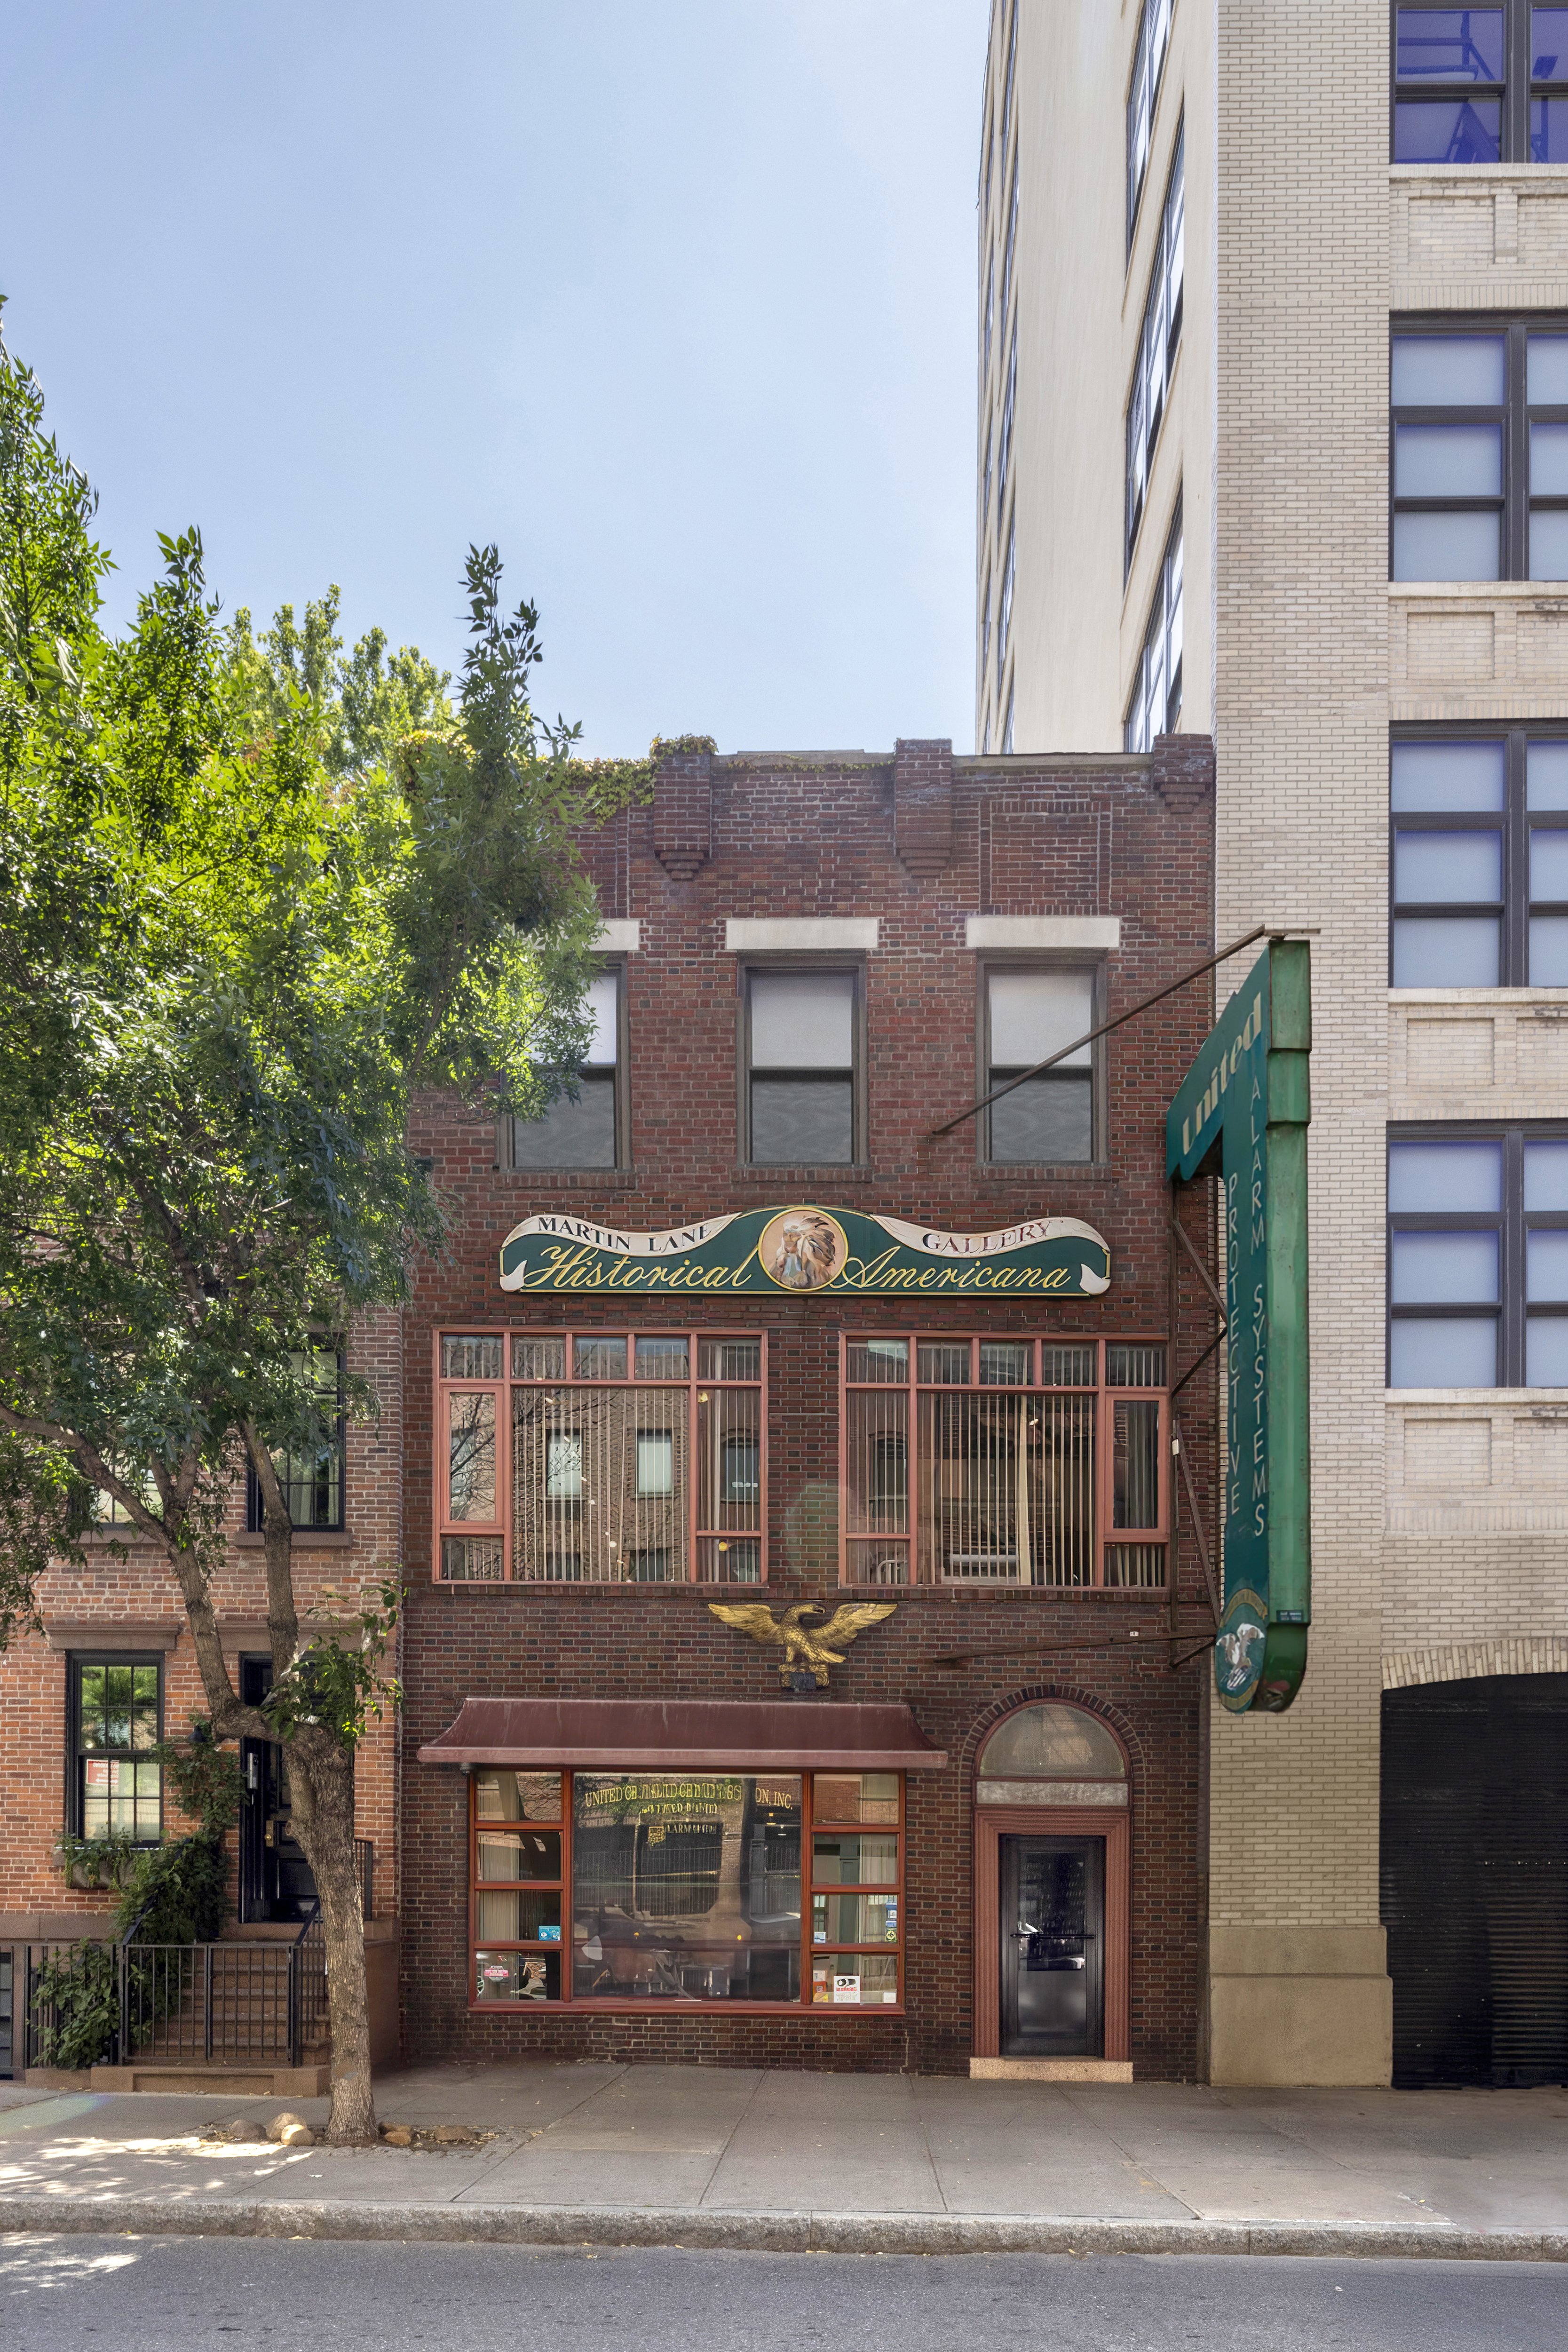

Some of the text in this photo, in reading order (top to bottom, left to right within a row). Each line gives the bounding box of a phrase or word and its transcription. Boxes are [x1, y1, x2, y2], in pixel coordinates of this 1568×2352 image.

[538, 1217, 1053, 1254] MARTIN LANE GALLERY
[523, 1244, 1071, 1288] Historical Americana
[1250, 1075, 1268, 1537] ALARM SYSTEMS
[1228, 1173, 1241, 1516] PROTECTIVE
[585, 1787, 623, 1807] UNITED
[773, 1791, 793, 1810] INC.
